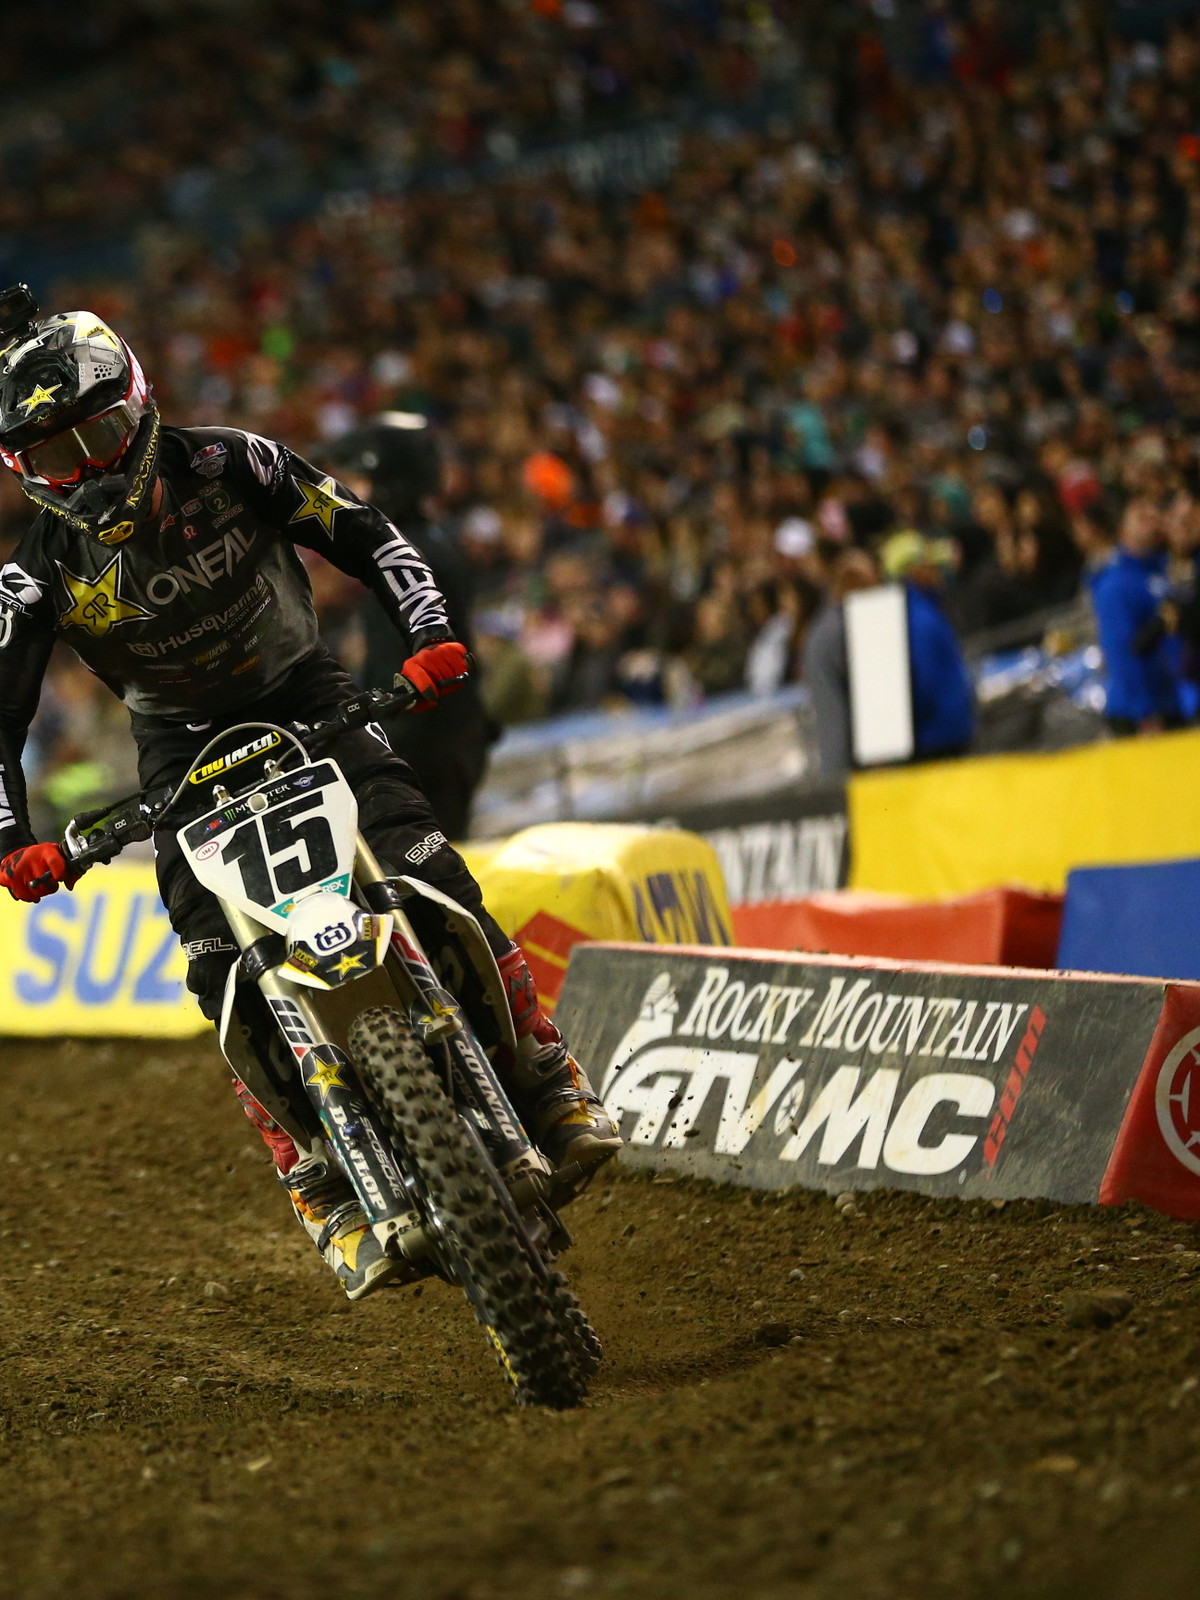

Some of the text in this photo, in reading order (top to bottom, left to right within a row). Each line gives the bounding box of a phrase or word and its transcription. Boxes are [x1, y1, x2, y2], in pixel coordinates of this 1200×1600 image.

[158, 573, 265, 655] Husqvarna
[221, 790, 339, 909] 15
[13, 891, 183, 1007] SUZ
[678, 966, 1029, 1064] ROCKY MOUNTAIN
[455, 1039, 521, 1142] DUNLOP
[359, 1114, 406, 1201] SCOSCHE
